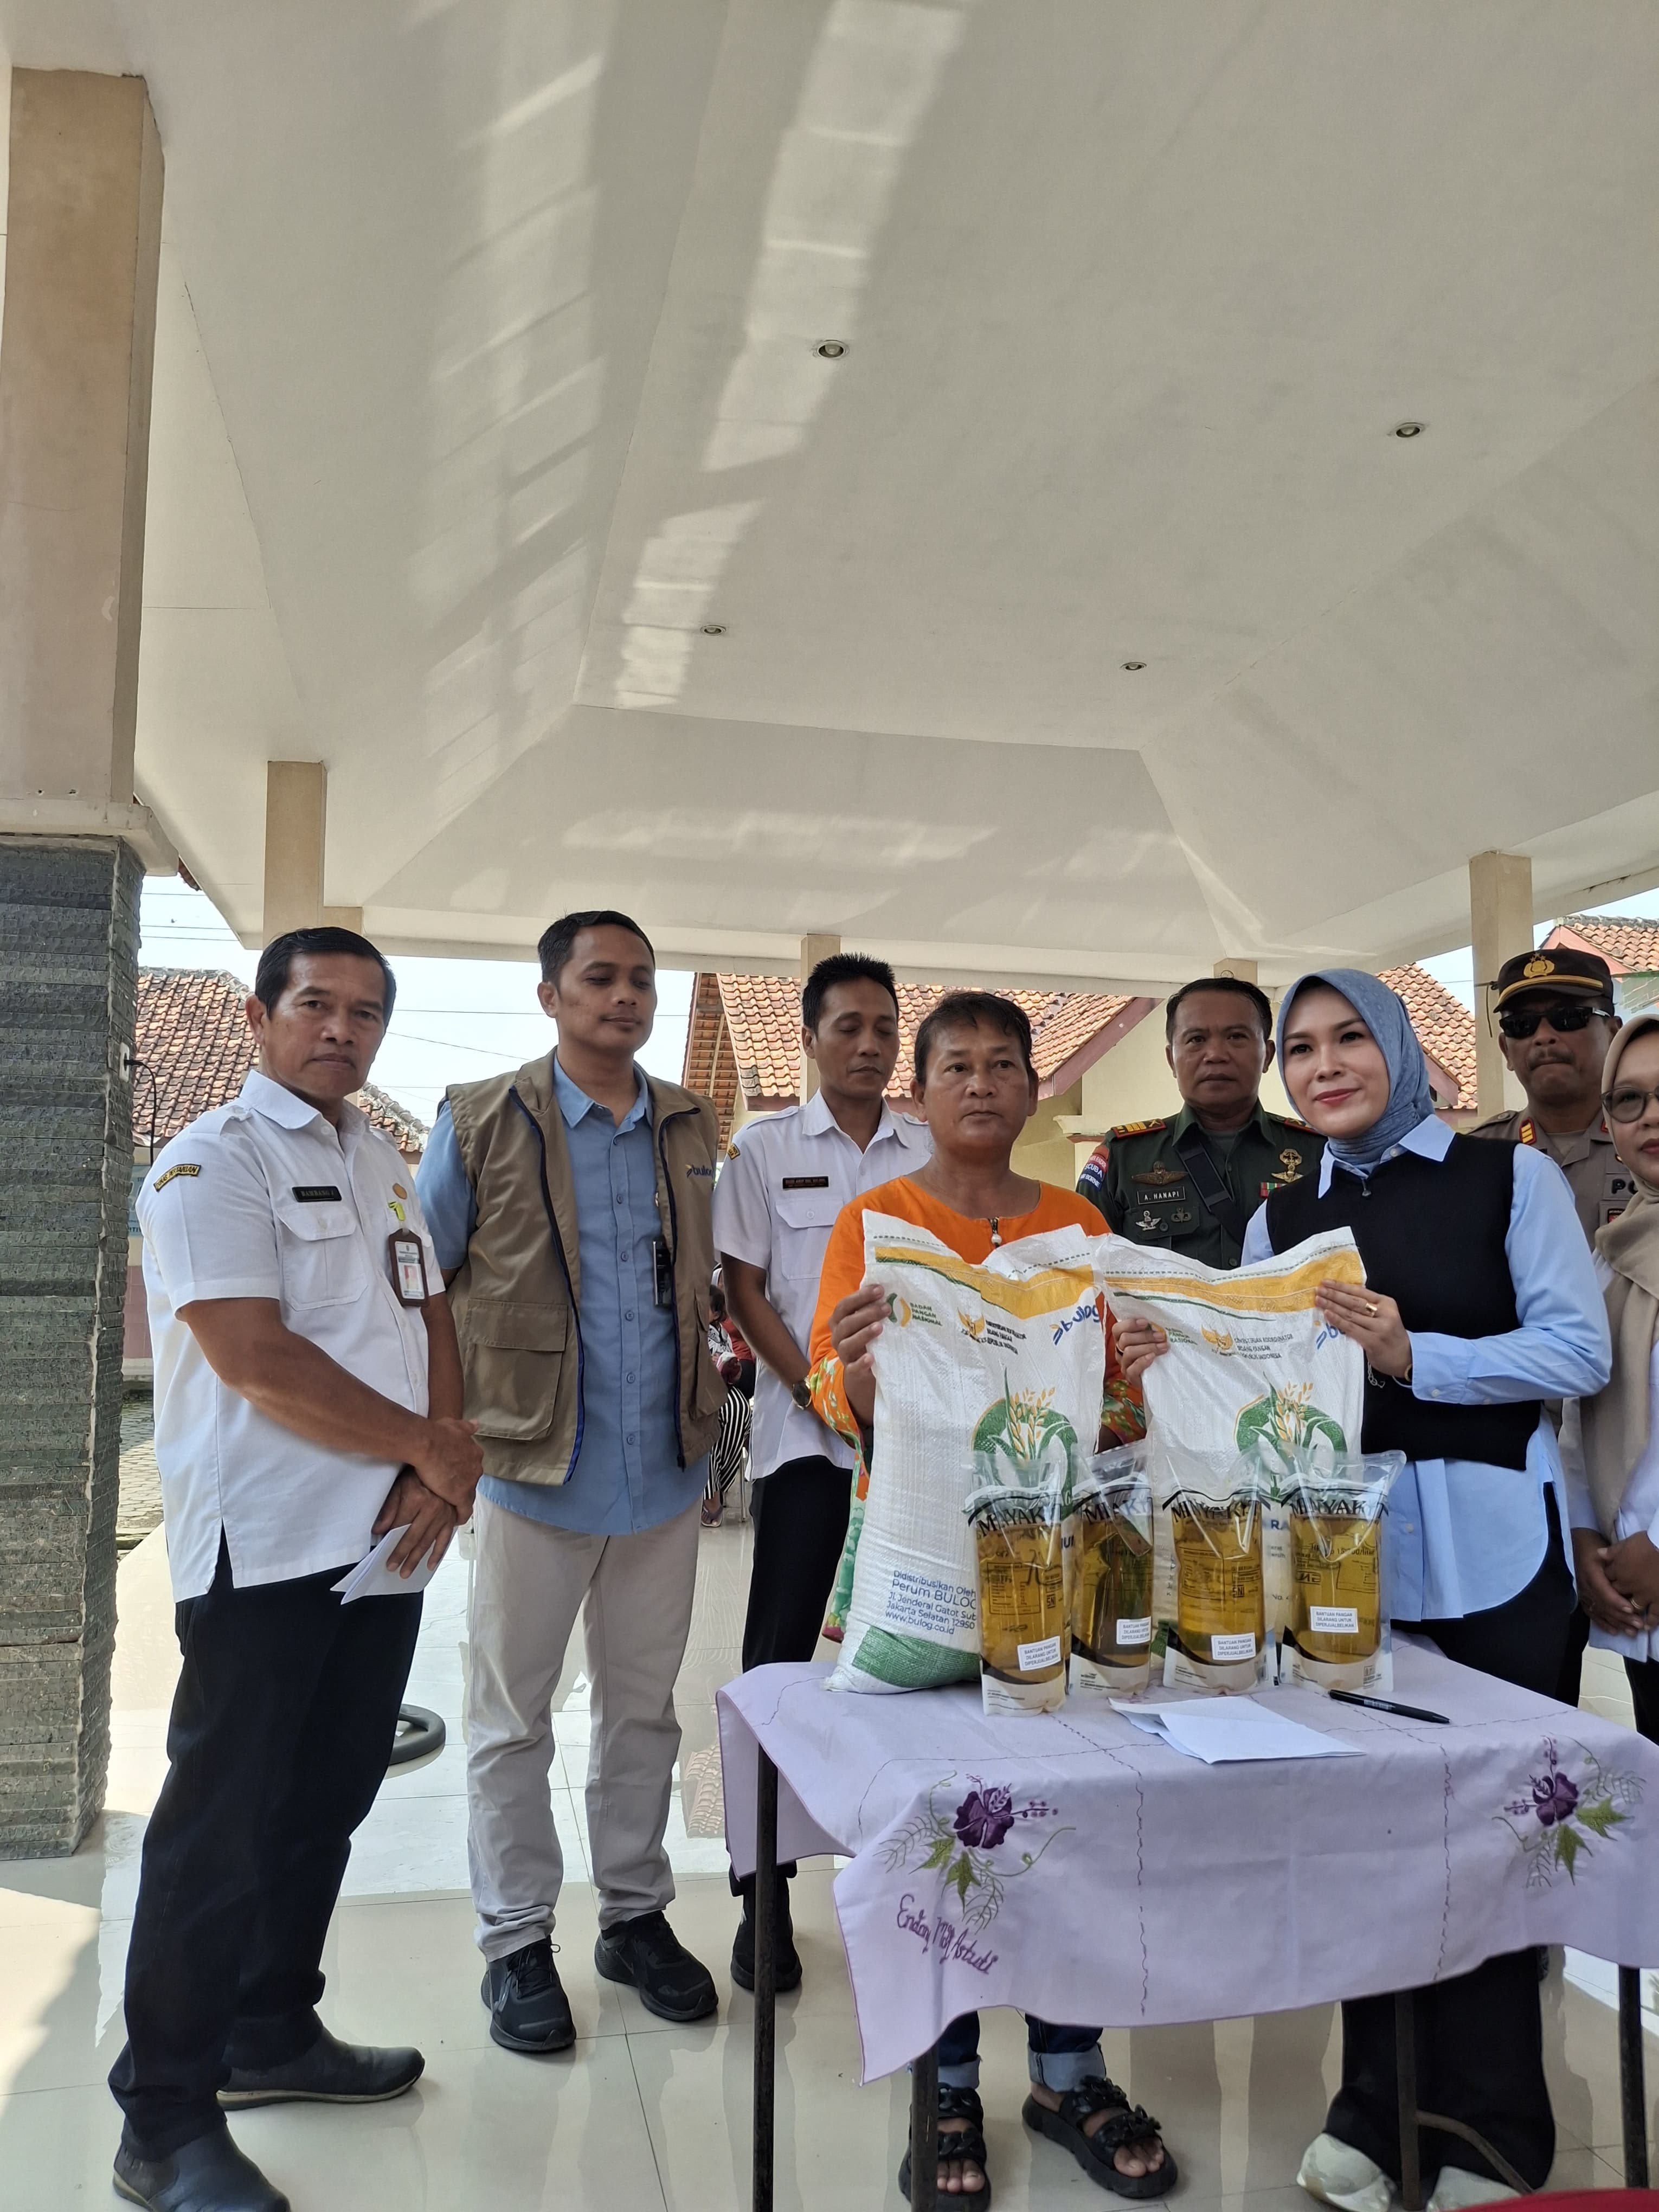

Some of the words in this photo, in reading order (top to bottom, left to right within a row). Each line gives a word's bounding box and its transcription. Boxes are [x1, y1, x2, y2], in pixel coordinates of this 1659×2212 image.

[1153, 1191, 1179, 1200] HANAPI
[910, 1302, 932, 1311] BADAN
[892, 1579, 930, 1598] Perum
[893, 1570, 953, 1592] Didistribusikan
[956, 1586, 976, 1598] Oleh
[886, 1601, 916, 1616] Jakarta
[918, 1609, 949, 1624] Selatan
[952, 1618, 975, 1630] 12950
[897, 1594, 933, 1610] Jenderal
[935, 1604, 959, 1617] Gatot
[885, 1611, 955, 1635] www.bulog.co.id
